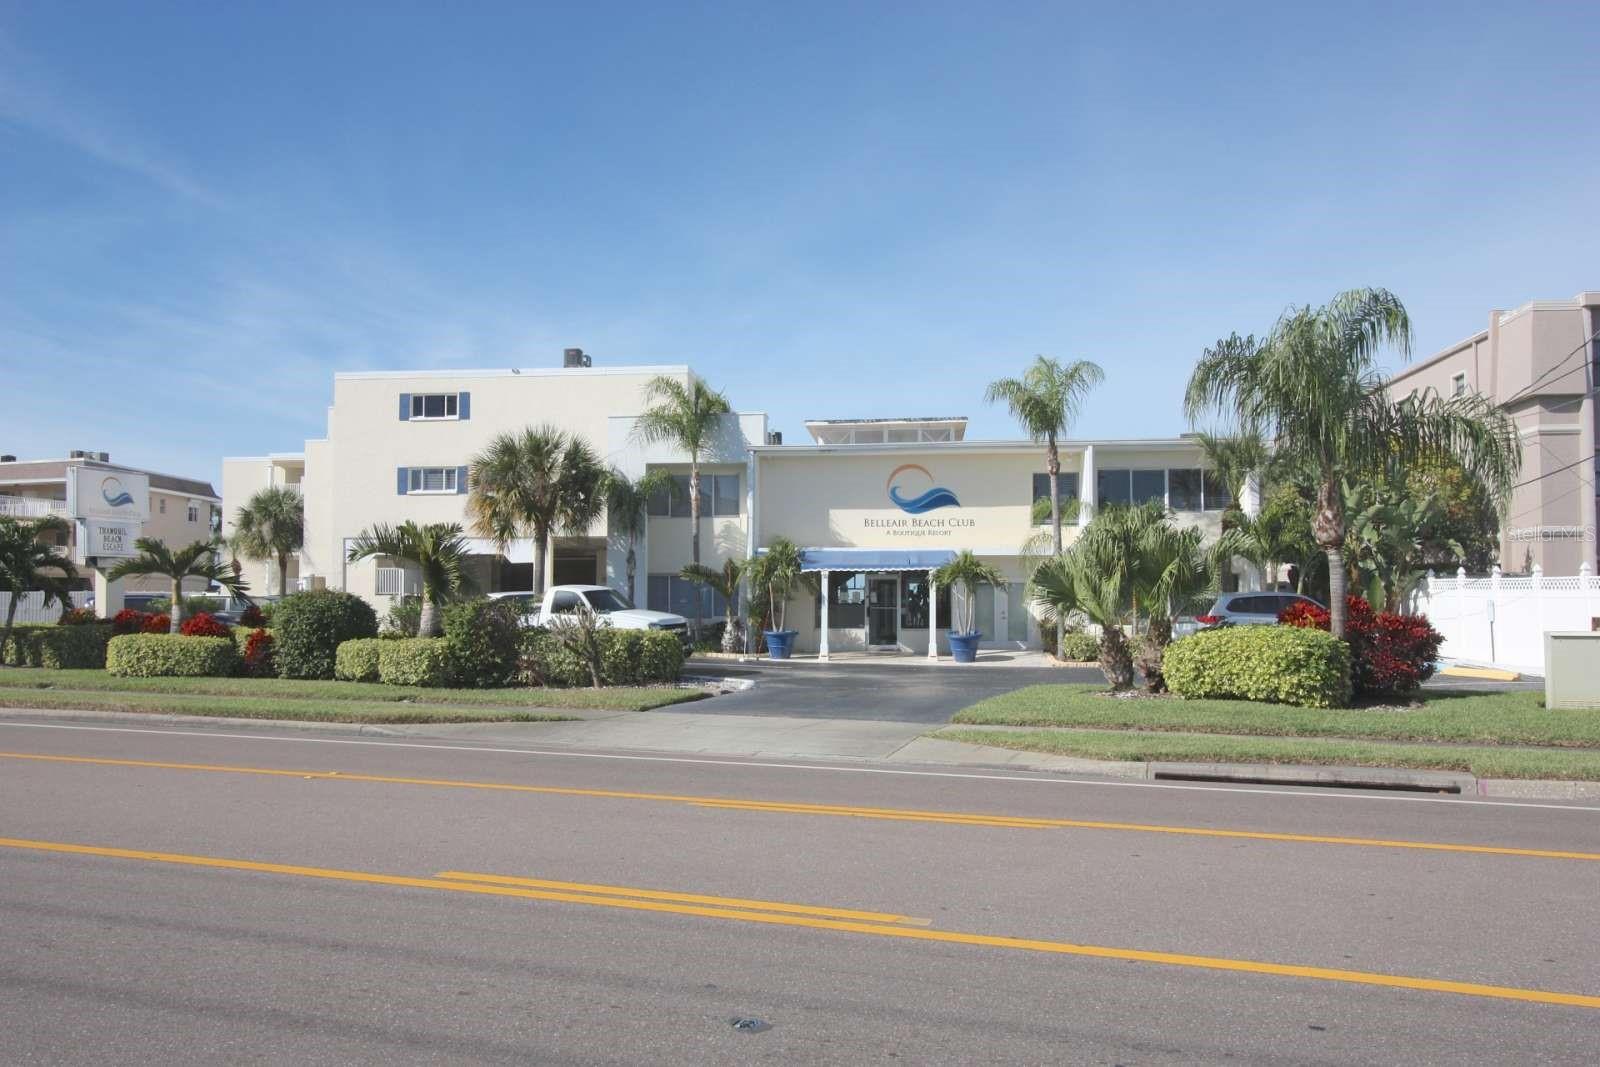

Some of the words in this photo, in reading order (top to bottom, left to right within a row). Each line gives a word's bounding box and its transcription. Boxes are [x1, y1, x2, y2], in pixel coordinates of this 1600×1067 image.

[864, 518, 908, 528] BELLEAIR
[912, 518, 945, 528] BEACH
[948, 518, 976, 527] CLUB
[99, 526, 127, 536] TRANQUIL
